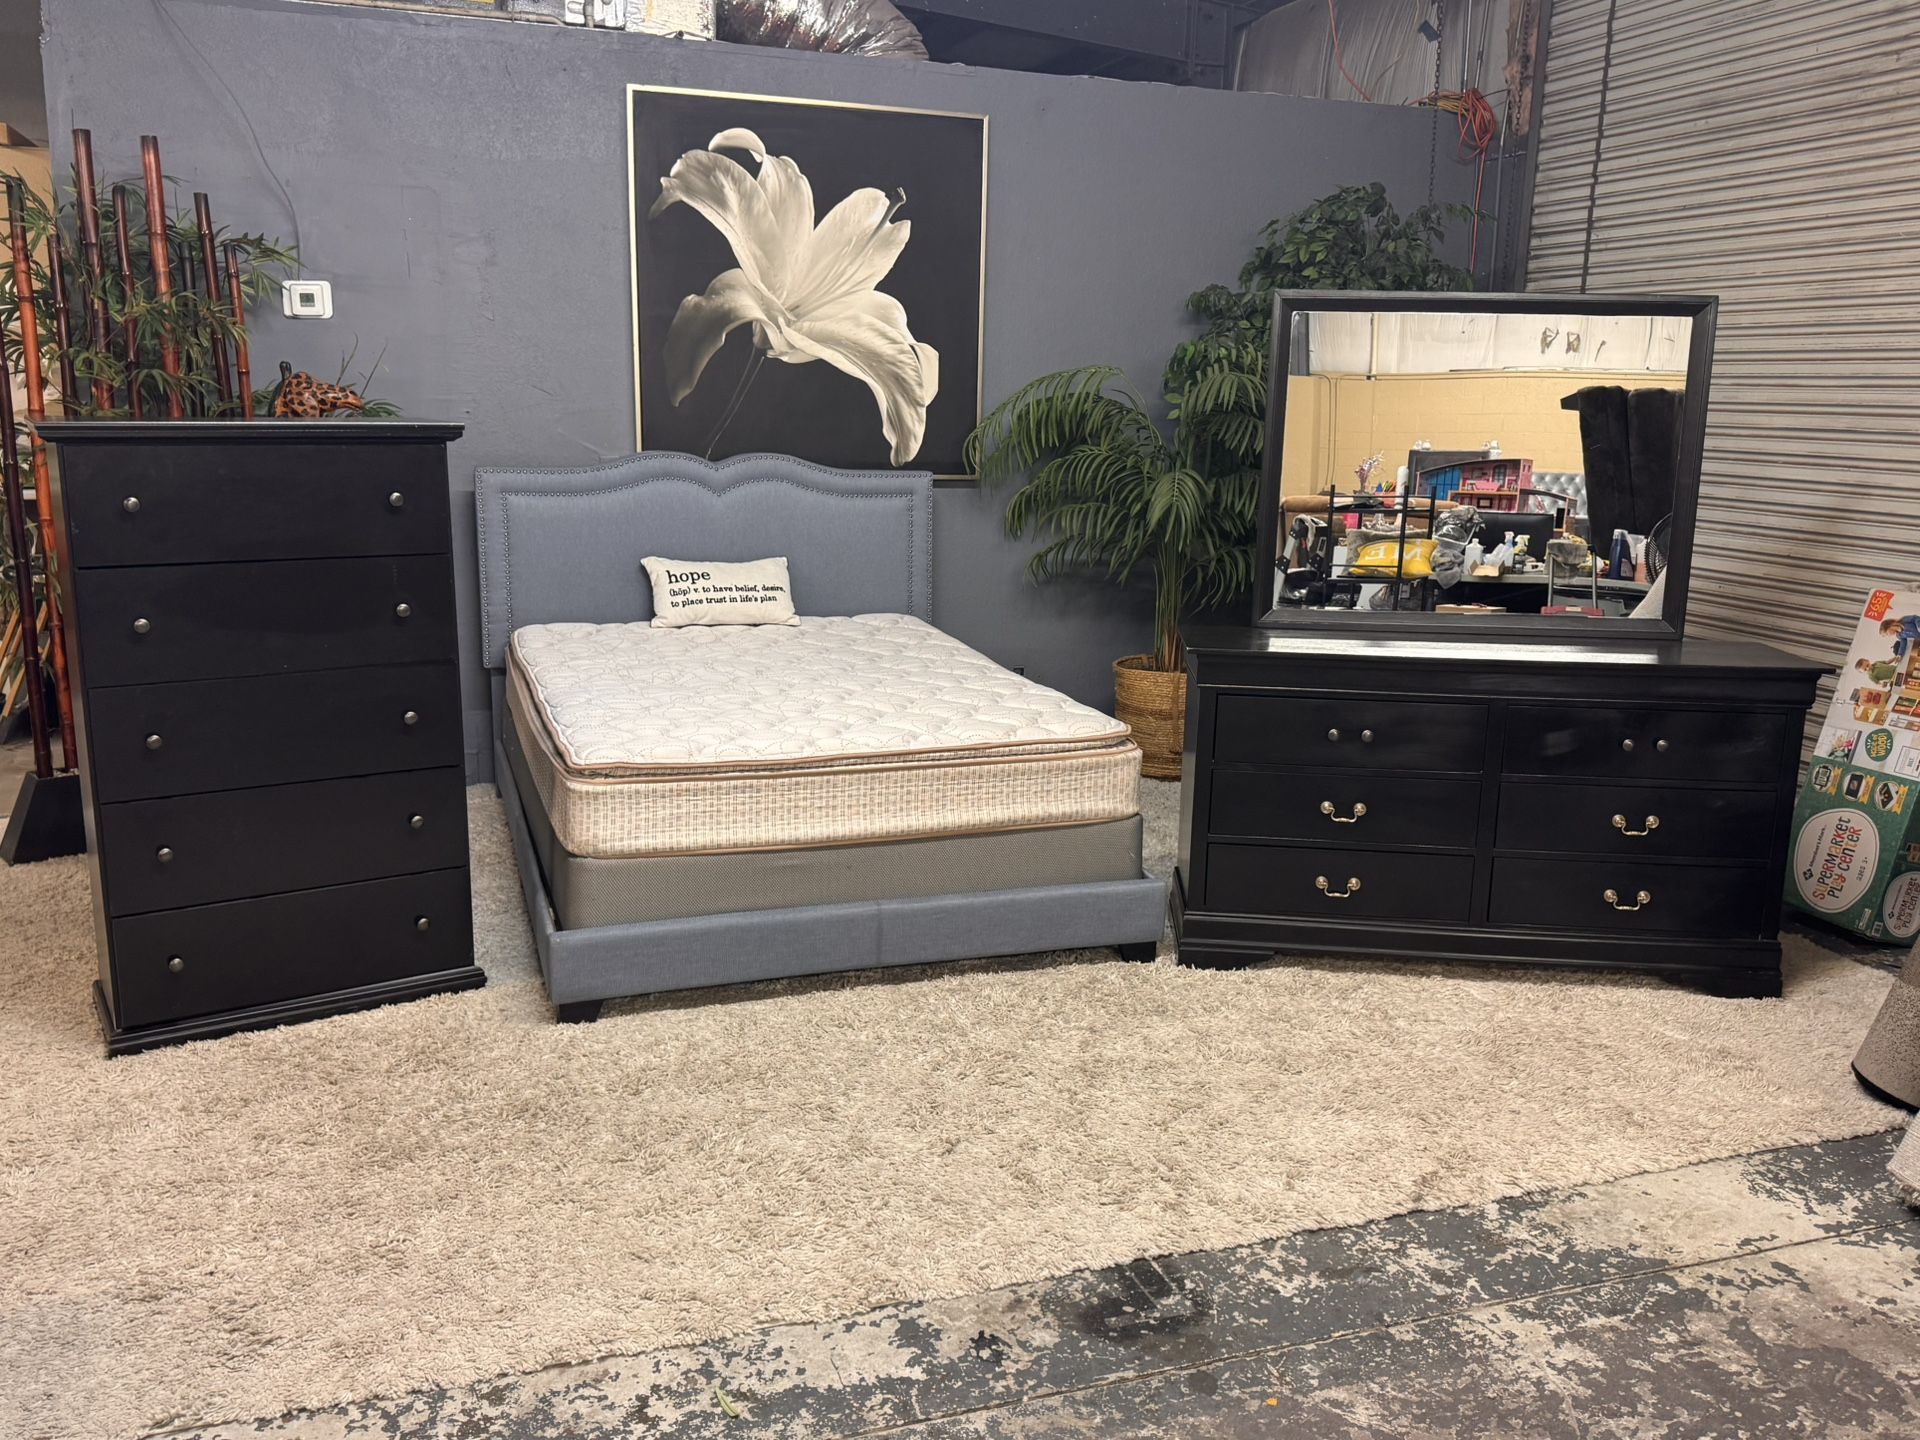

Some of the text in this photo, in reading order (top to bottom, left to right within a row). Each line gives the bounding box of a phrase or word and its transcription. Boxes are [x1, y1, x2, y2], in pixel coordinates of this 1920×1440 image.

[666, 570, 711, 584] hope
[712, 585, 733, 593] have
[734, 585, 760, 593] belief,
[761, 584, 786, 593] desire,
[681, 598, 704, 608] place
[705, 596, 727, 604] trust
[729, 595, 738, 603] in
[739, 595, 759, 603] life's
[760, 594, 778, 604] plan
